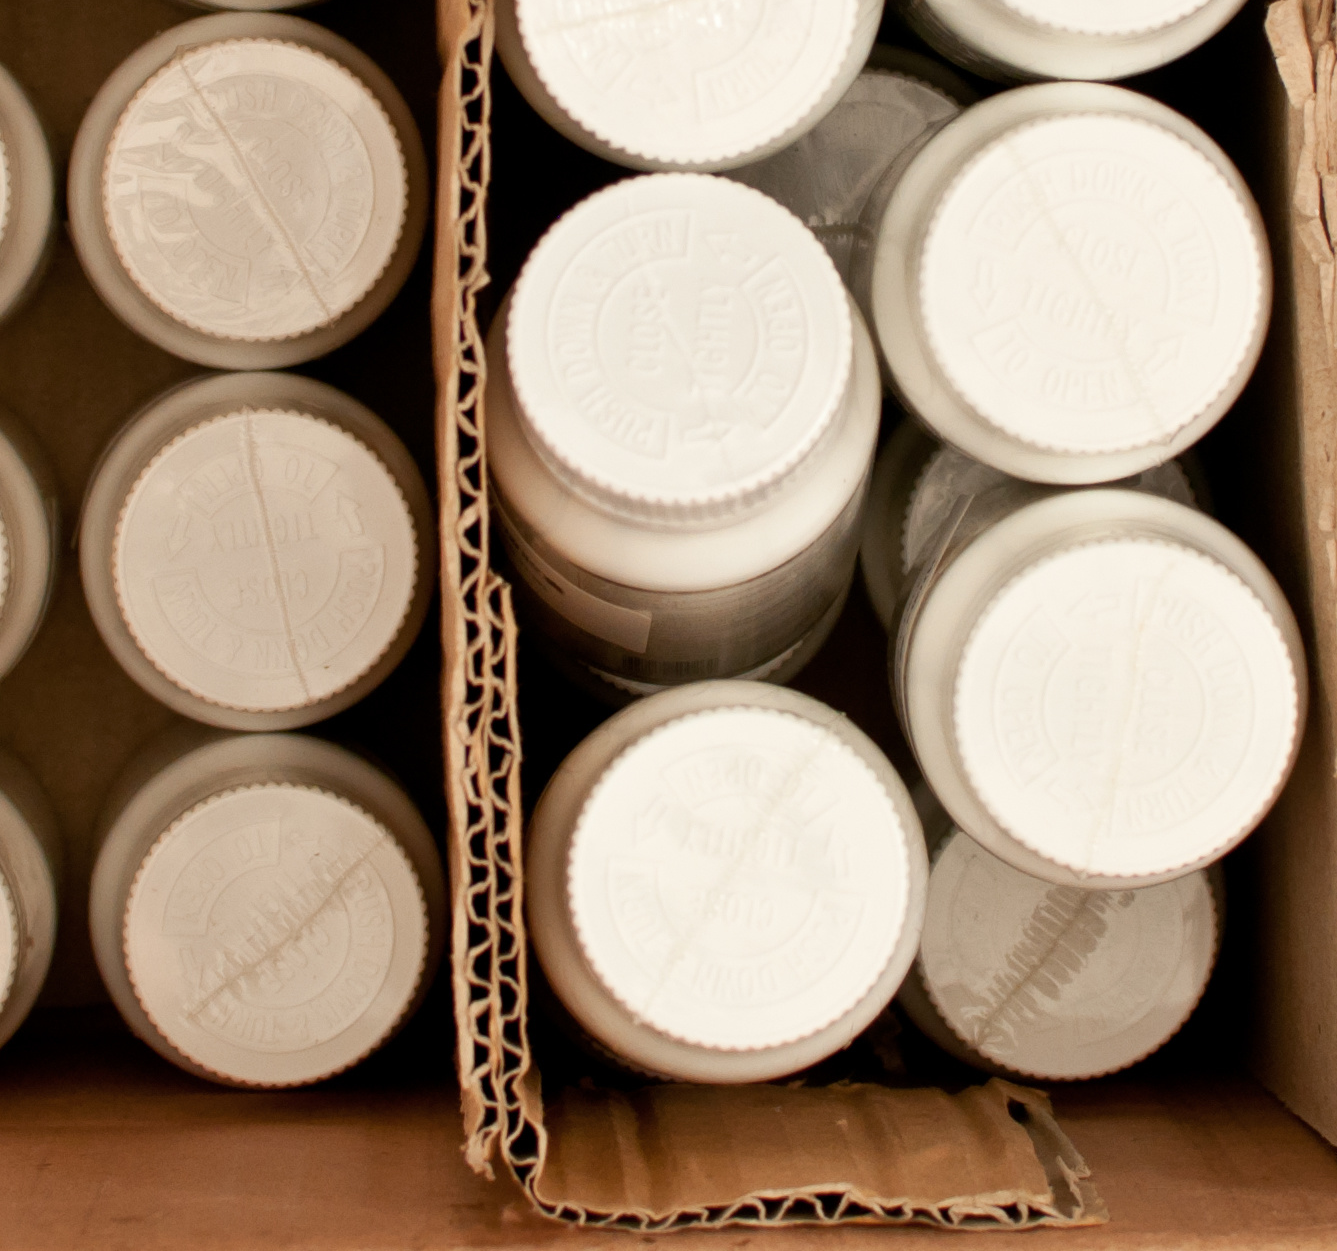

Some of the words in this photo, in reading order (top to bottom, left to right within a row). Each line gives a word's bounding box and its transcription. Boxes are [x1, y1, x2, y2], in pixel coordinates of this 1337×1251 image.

[591, 211, 675, 266] TURN
[555, 286, 597, 381] DOWN
[624, 281, 669, 375] CLOSE
[750, 275, 800, 363] OPEN
[576, 381, 654, 453] PUSH
[743, 372, 790, 423] TO
